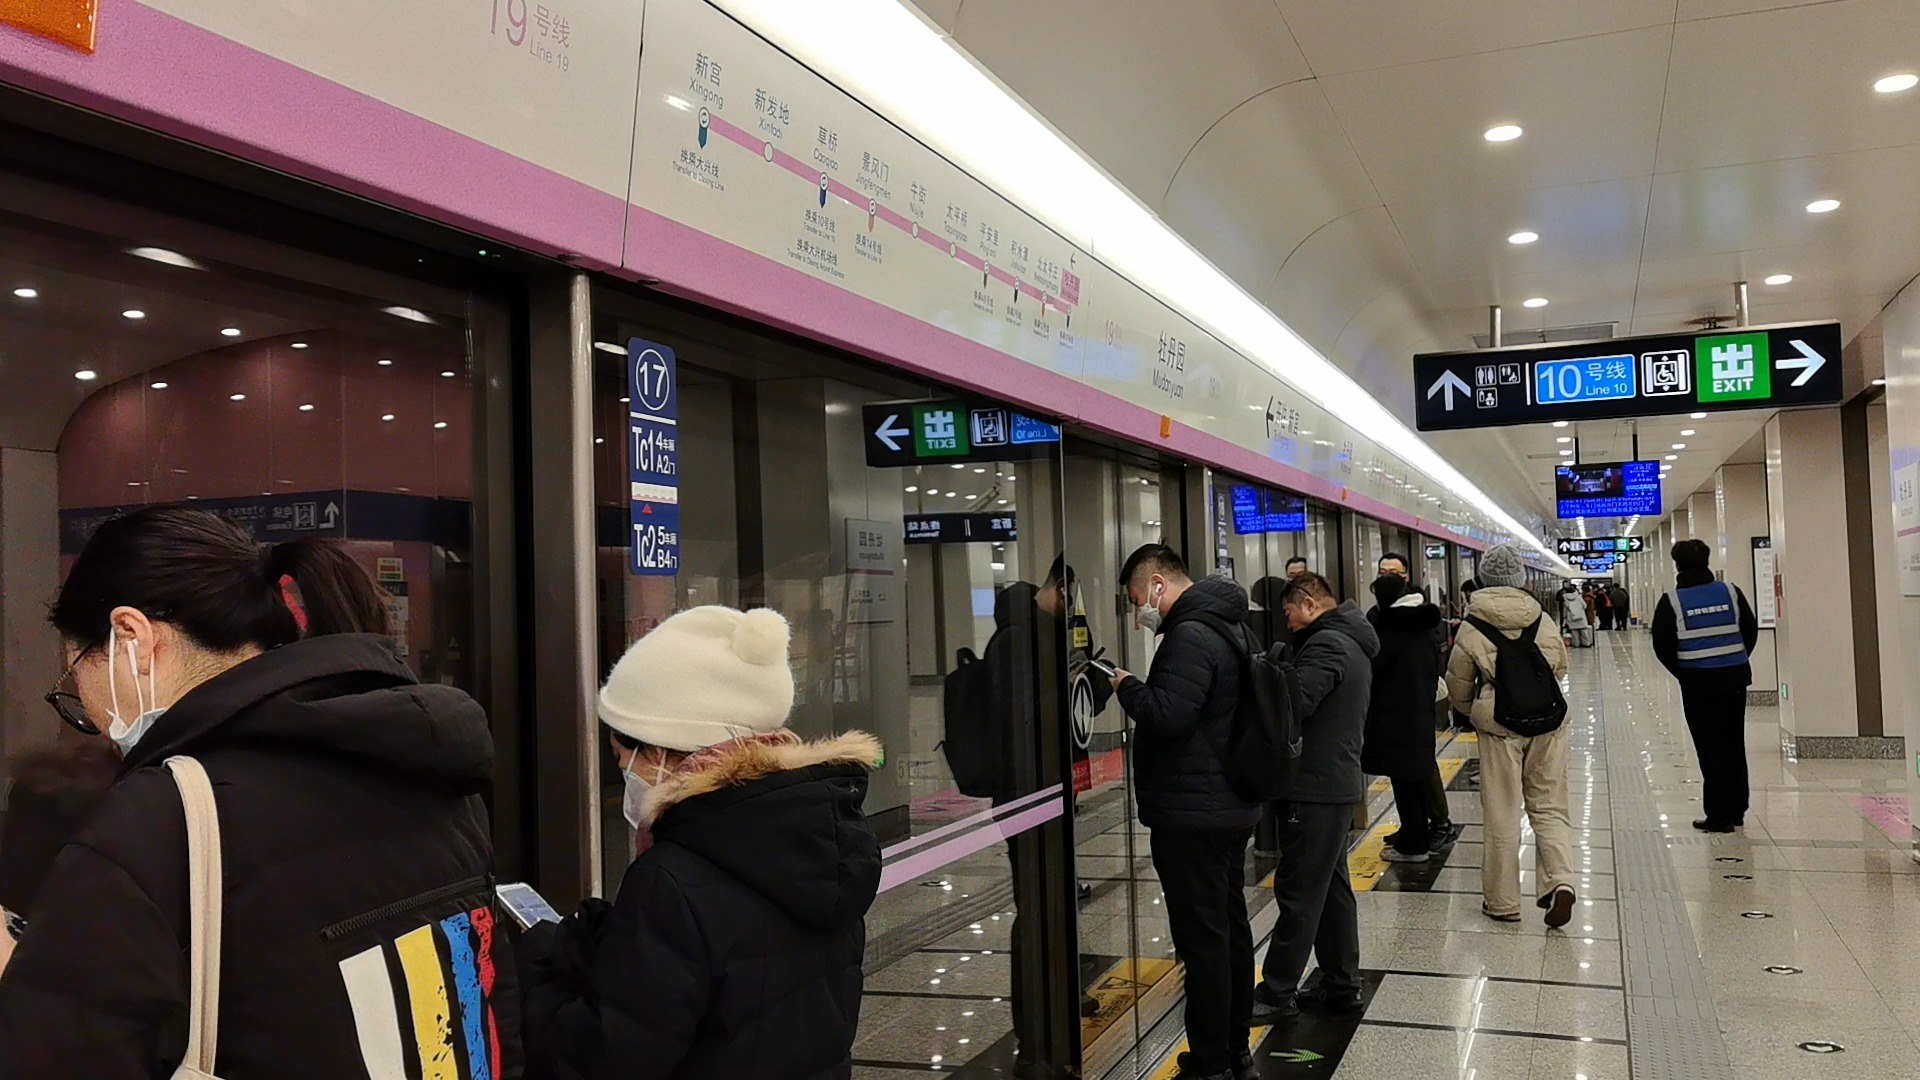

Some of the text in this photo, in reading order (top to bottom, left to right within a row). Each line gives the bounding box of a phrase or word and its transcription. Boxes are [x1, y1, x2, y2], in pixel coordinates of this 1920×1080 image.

[490, 0, 570, 48] 19 号线
[529, 38, 569, 72] Line 19
[695, 51, 722, 87] 新宫
[689, 77, 724, 110] Xingong
[754, 88, 791, 125] 新发地
[816, 125, 838, 153] 草桥
[1158, 329, 1186, 374] 牡丹园
[639, 361, 667, 398] 17
[1151, 367, 1185, 400] Mudanyuan
[1539, 364, 1583, 399] 10
[1585, 361, 1627, 383] 号线
[1585, 378, 1754, 397] Line 10 EXIT
[631, 425, 655, 472] Tc1
[656, 453, 676, 475] A2门
[633, 522, 657, 568] Tc2
[658, 549, 678, 570] B4门
